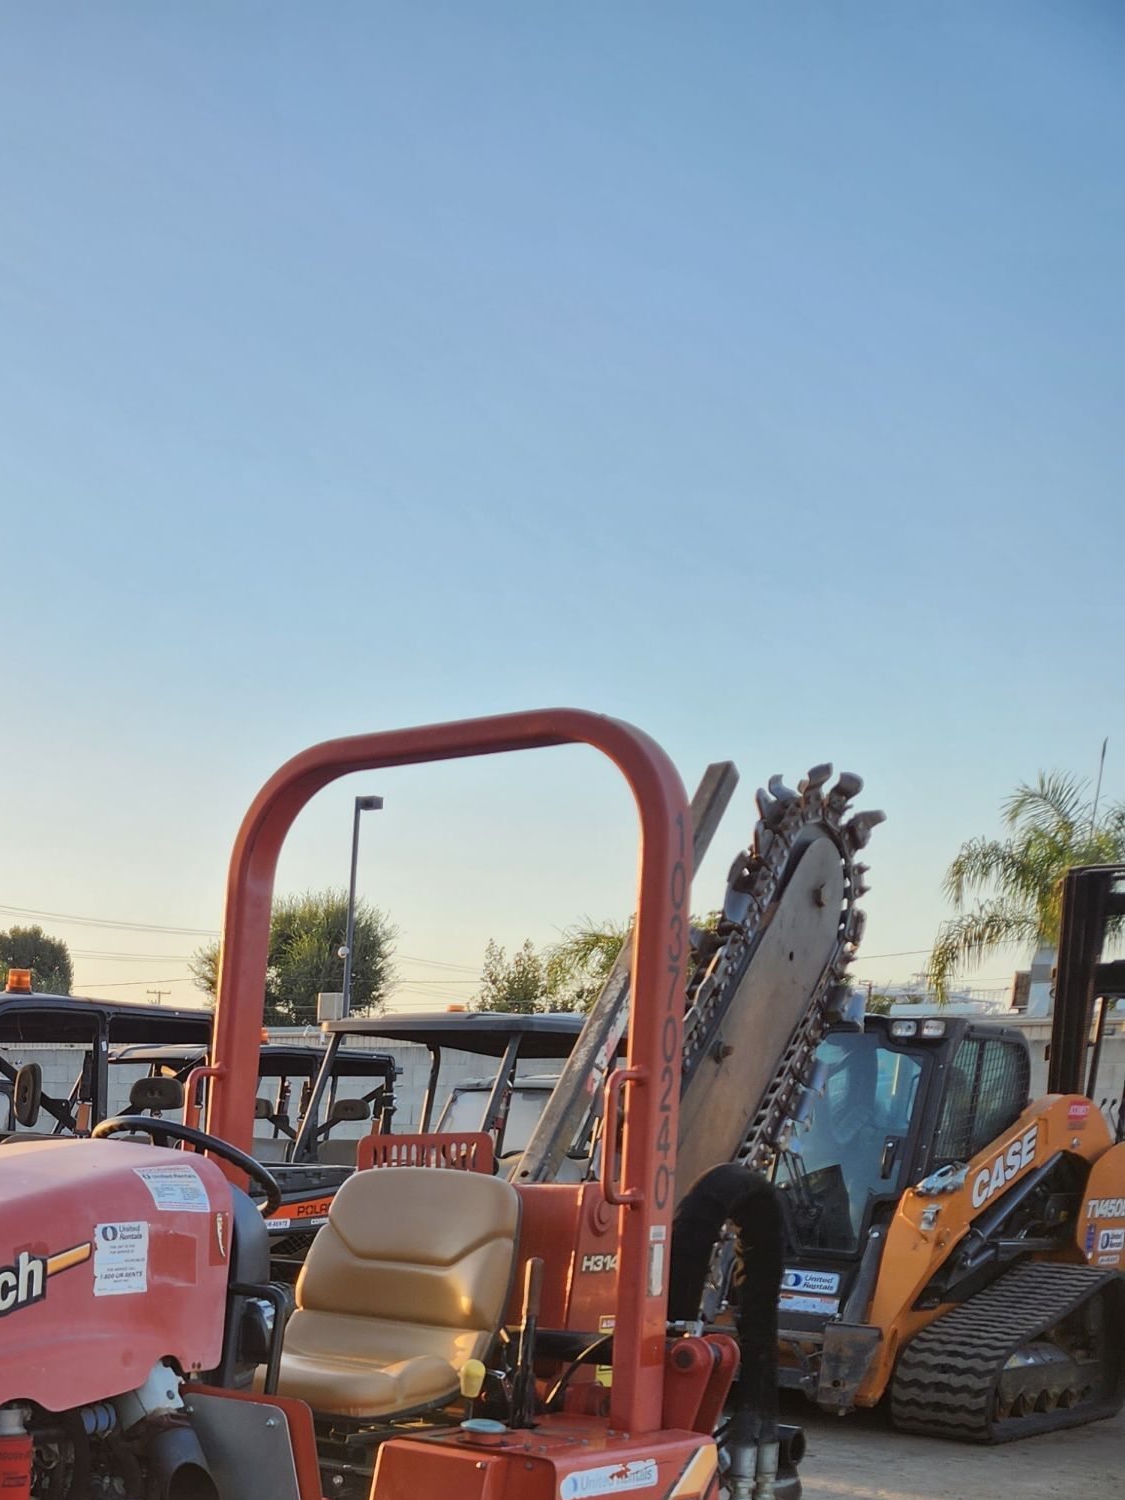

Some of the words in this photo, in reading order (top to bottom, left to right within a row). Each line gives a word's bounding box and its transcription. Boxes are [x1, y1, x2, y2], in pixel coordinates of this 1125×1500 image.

[972, 1125, 1039, 1209] CASE
[119, 1225, 140, 1233] United
[119, 1233, 143, 1241] Rentals
[804, 1274, 835, 1284] United
[803, 1281, 834, 1290] Rentals
